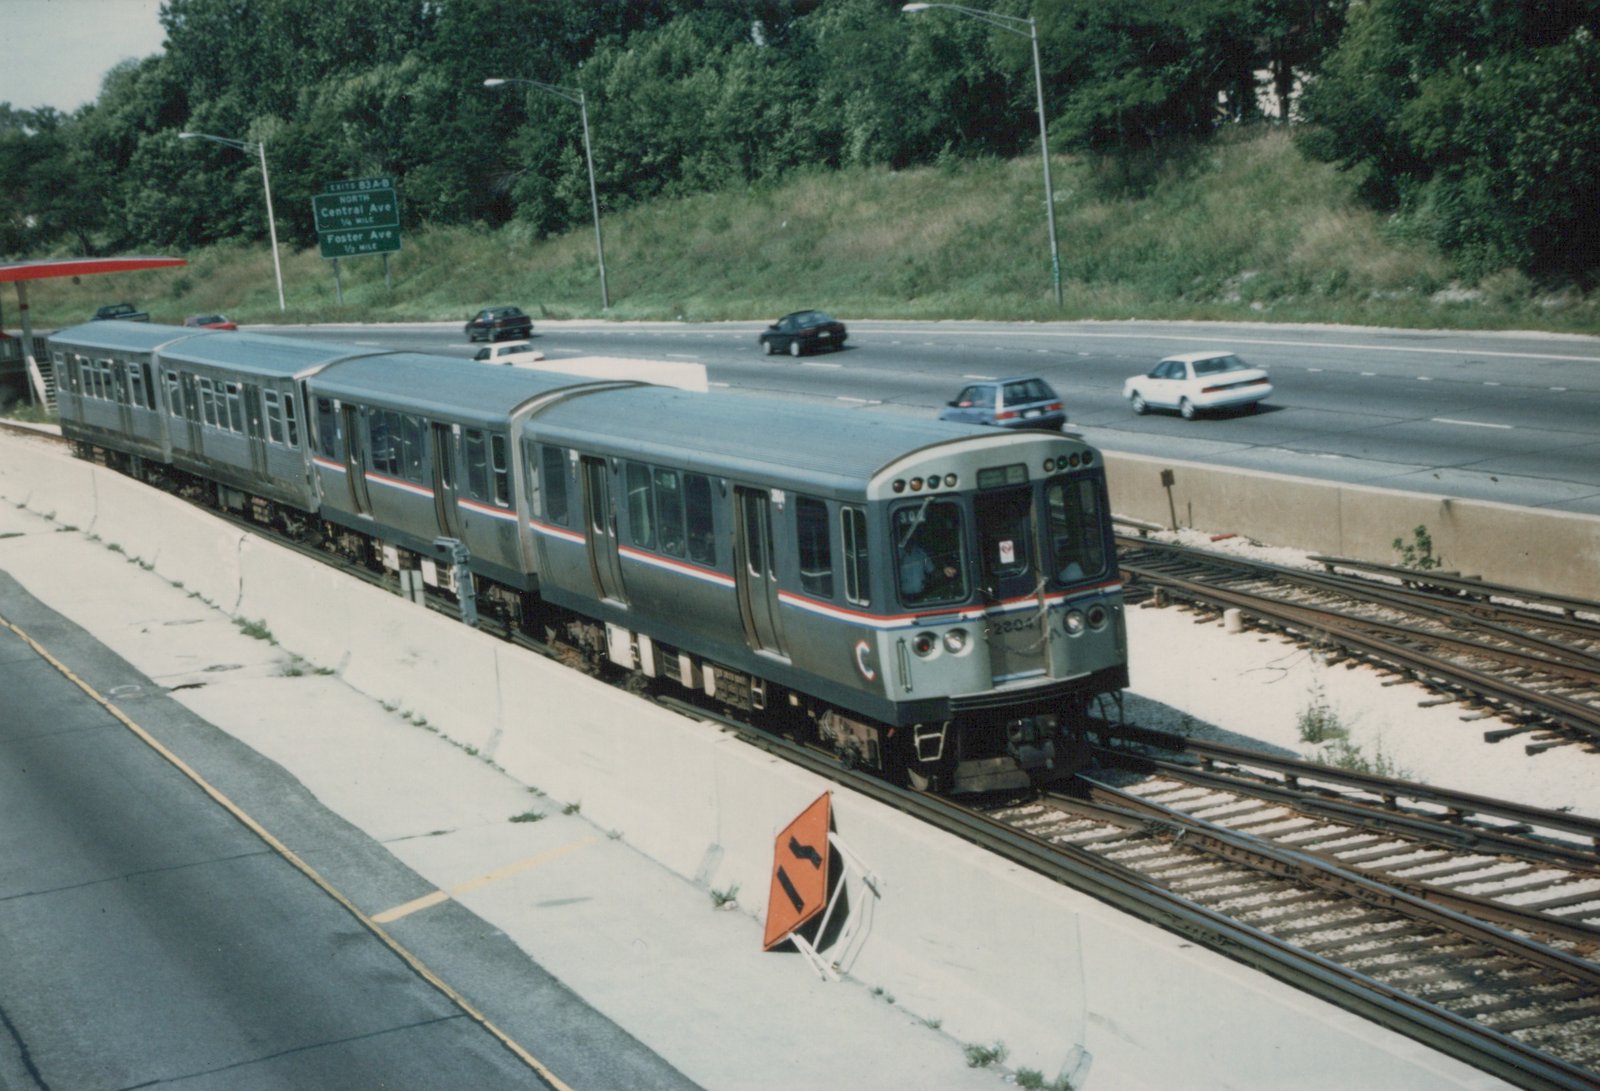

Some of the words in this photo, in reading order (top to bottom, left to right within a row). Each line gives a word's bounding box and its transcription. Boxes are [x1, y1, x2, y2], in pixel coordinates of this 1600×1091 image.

[339, 194, 370, 204] NORTH
[321, 205, 364, 217] Central
[369, 203, 391, 212] Ave
[356, 216, 374, 224] MILE
[327, 233, 363, 243] Foster
[371, 230, 392, 239] Ave
[359, 242, 377, 250] MILE
